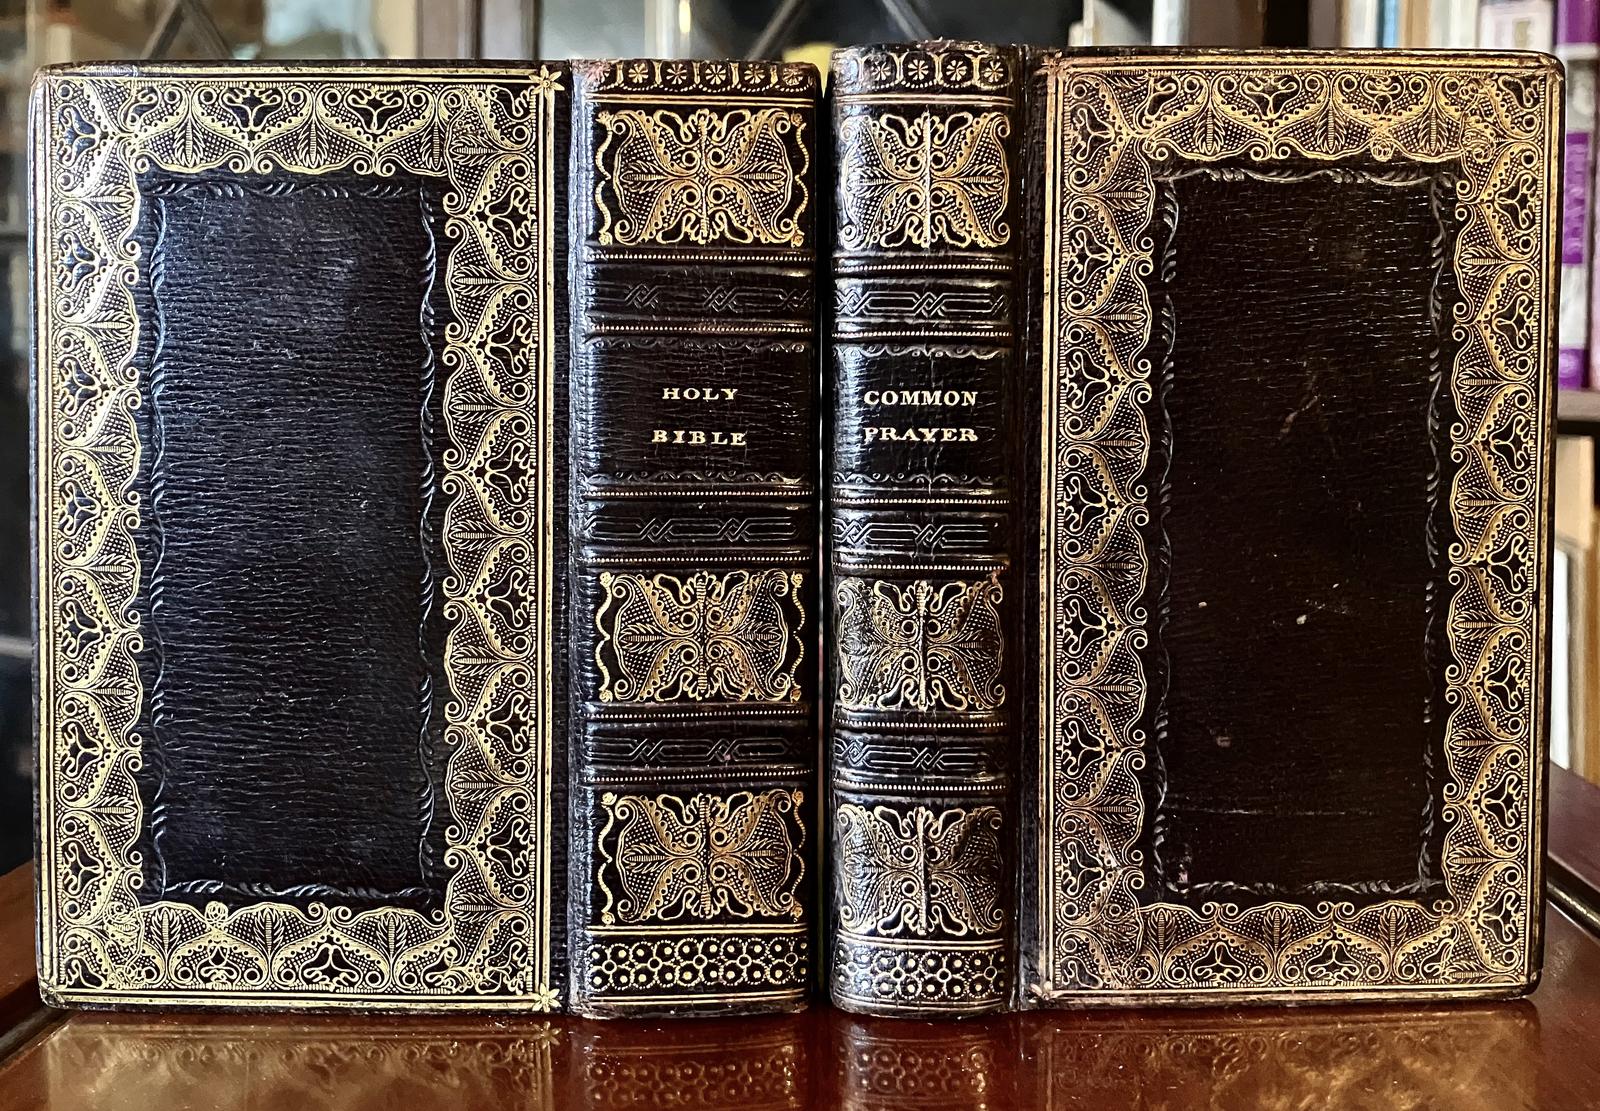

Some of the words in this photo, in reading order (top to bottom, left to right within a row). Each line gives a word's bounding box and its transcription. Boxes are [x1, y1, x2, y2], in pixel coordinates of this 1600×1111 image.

[662, 387, 738, 401] HOLY
[863, 390, 978, 406] COMMON
[651, 429, 748, 446] BIBLE
[863, 427, 978, 445] PRAYER
